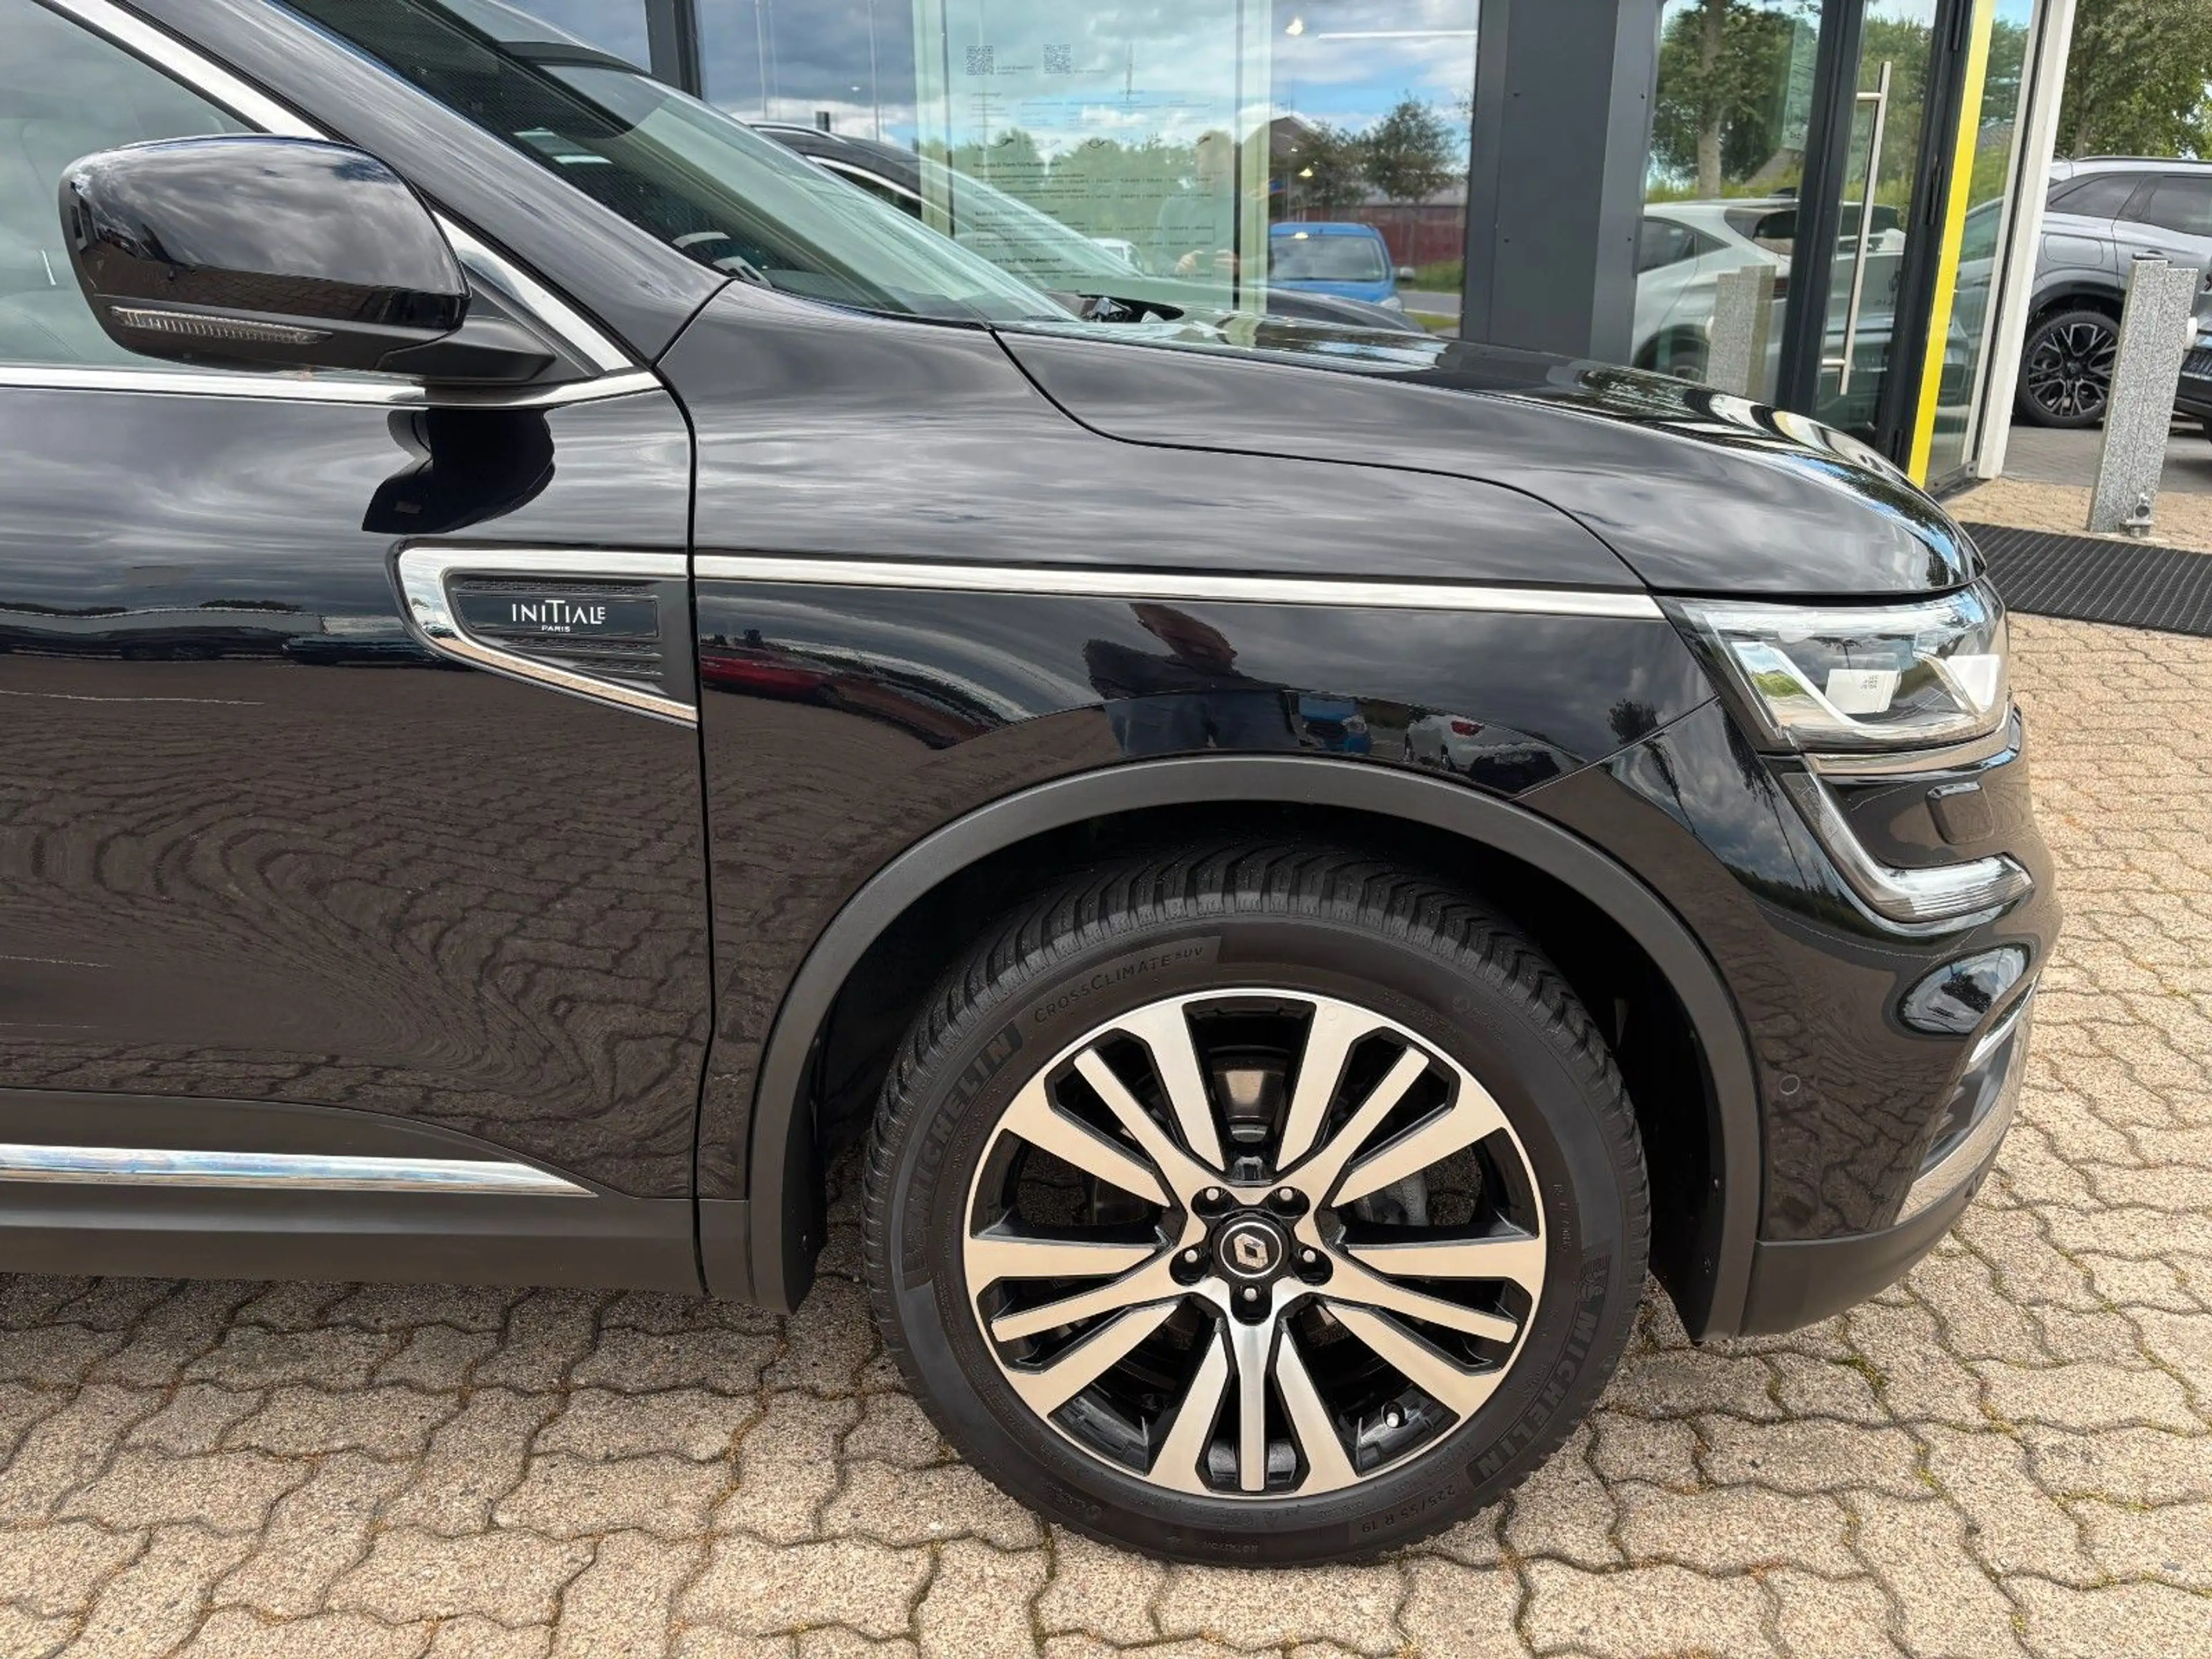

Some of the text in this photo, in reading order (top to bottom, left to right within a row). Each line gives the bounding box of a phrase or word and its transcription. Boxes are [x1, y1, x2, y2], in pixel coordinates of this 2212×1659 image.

[512, 600, 606, 624] INITIALE
[908, 1033, 1013, 1219] MICHELIN
[1478, 1310, 1598, 1479] MICHELIN
[1362, 1484, 1456, 1533] 225/55 R 19
